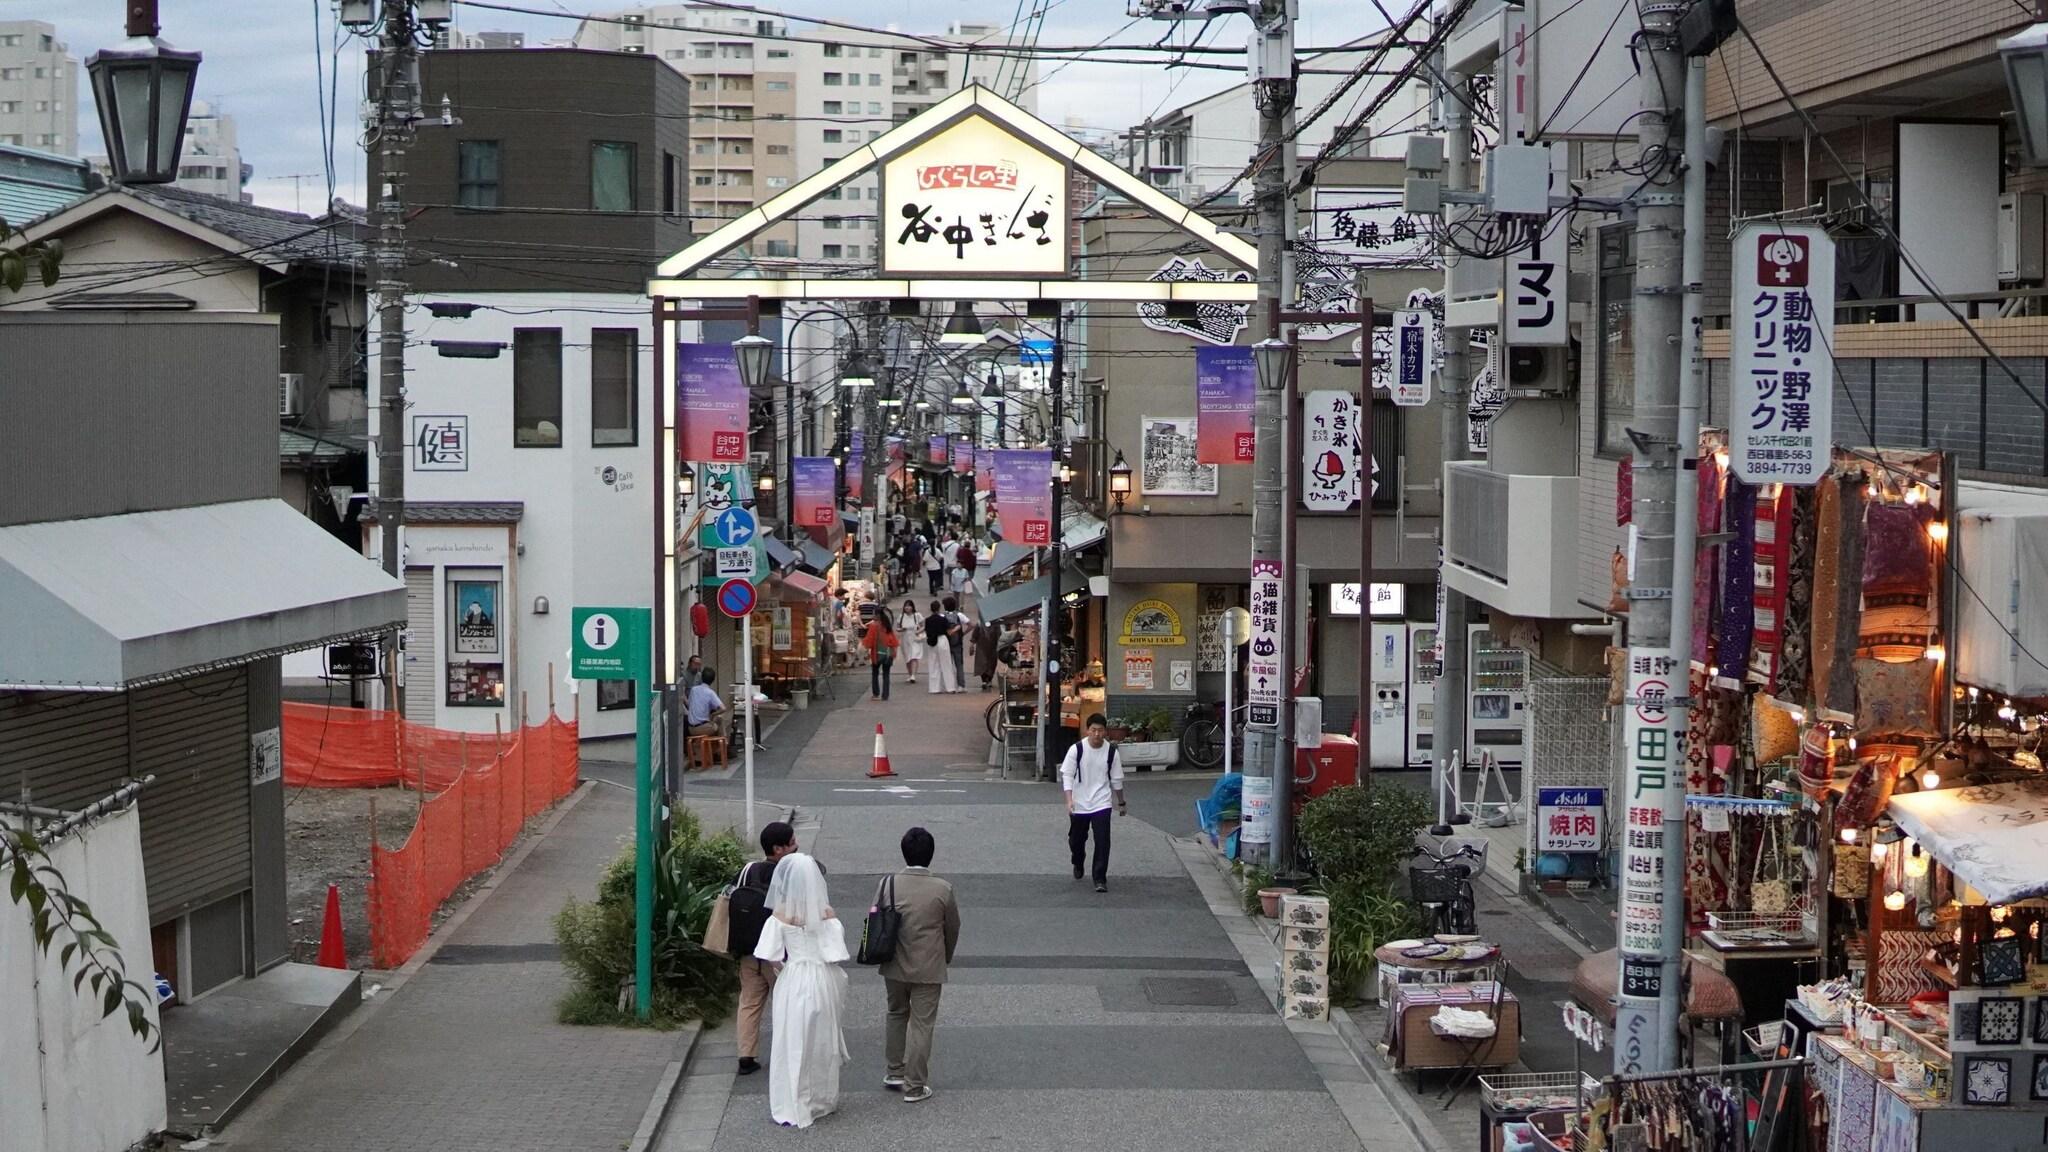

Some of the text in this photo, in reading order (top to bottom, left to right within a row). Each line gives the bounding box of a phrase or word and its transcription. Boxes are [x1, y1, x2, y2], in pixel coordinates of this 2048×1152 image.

[918, 159, 1017, 190] ひぐらしの里
[898, 185, 1053, 259] 谷中ぎんざ
[1331, 211, 1418, 249] 後藤の飴
[1751, 291, 1779, 431] クリニック
[1781, 291, 1812, 433] 動物・野澤
[1332, 398, 1348, 448] かき氷
[717, 436, 739, 446] 谷中
[1747, 449, 1813, 460] 西日暮里6-56-3
[1747, 462, 1812, 475] 3894-7739
[1308, 490, 1348, 502] ひみつ堂
[719, 551, 753, 560] 自転車を除く
[719, 559, 753, 567] 一方通行
[1253, 592, 1262, 627] のお店
[1262, 583, 1278, 633] 猫雑貨
[1643, 689, 1665, 714] 質
[1635, 728, 1666, 799] 田戸
[1555, 792, 1588, 805] Asahi
[1549, 814, 1596, 836] 焼肉
[1548, 840, 1595, 848] サラリーマン
[1628, 978, 1660, 990] 3-13
